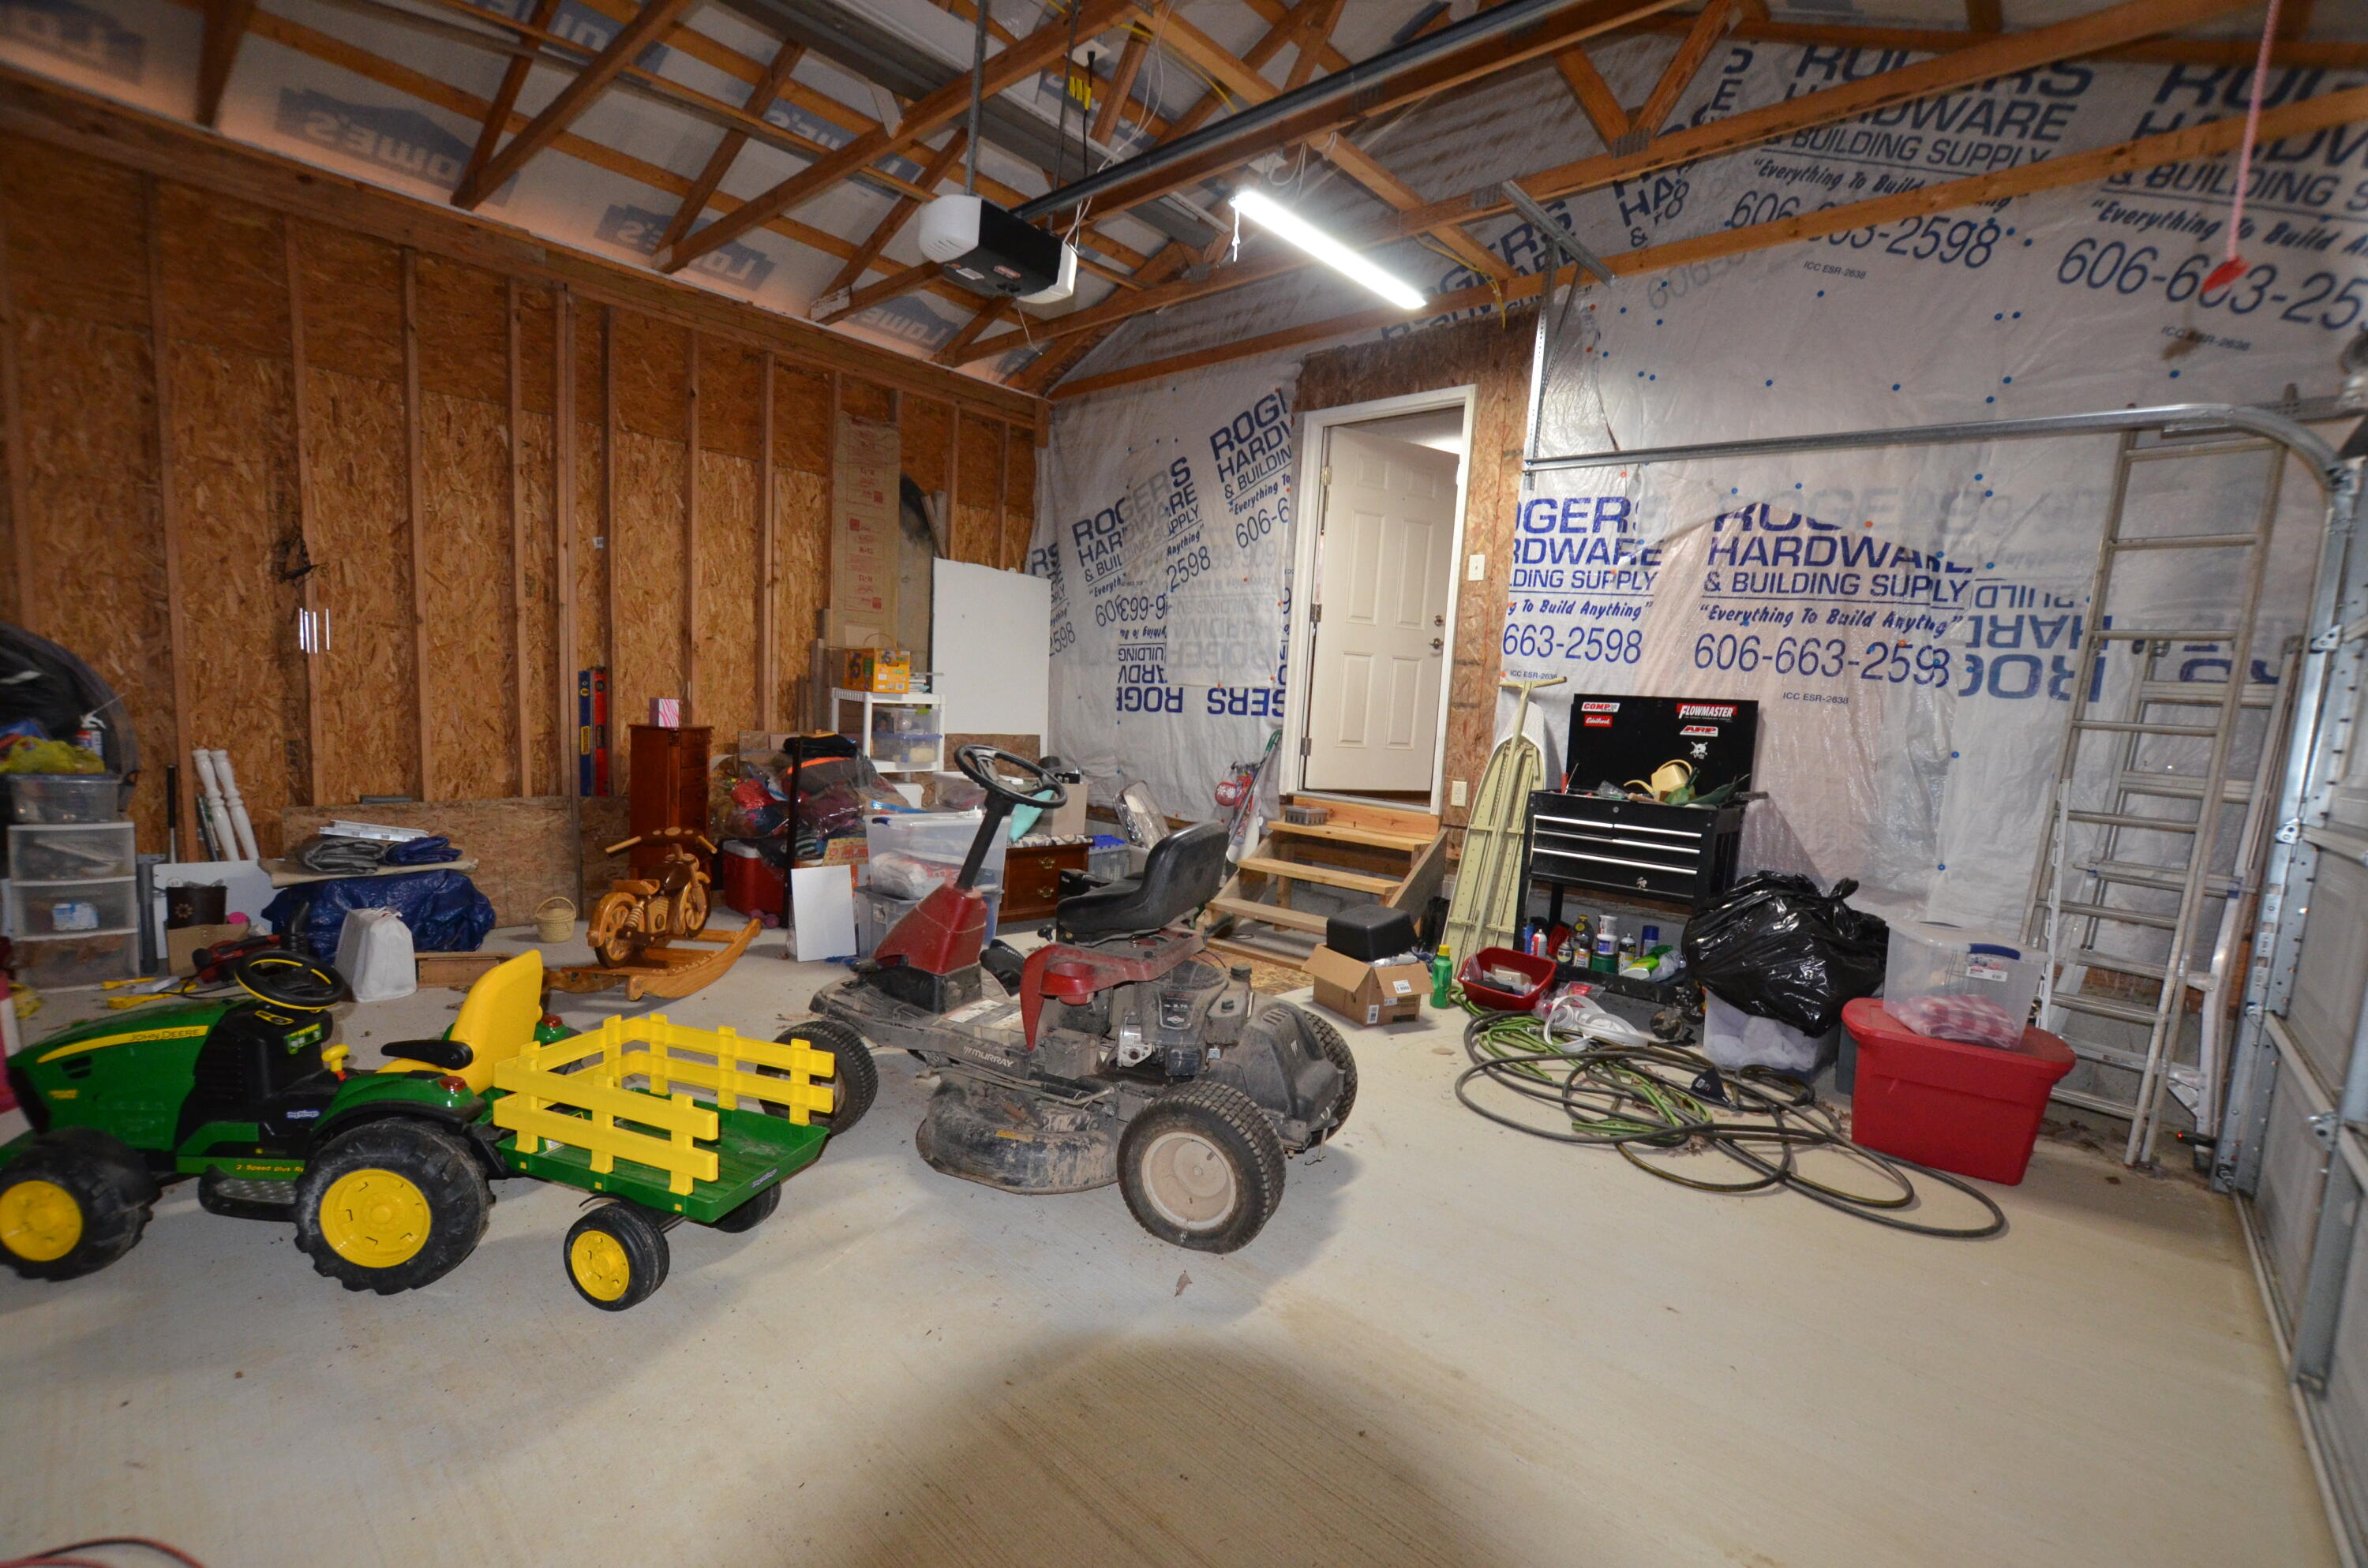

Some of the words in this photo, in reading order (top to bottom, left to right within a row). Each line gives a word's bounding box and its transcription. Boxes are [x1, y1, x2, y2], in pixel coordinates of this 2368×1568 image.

[1785, 83, 2078, 143] DWARE
[1790, 126, 1924, 163] BUILDING
[1848, 170, 1868, 190] To
[2145, 162, 2340, 207] BUILDING
[1729, 189, 2002, 269] 6063-2598
[2262, 221, 2339, 251] Build
[2057, 237, 2368, 331] 606-63-25
[1237, 443, 1293, 492] BUILDIN
[1088, 575, 1122, 598] “Everyth
[1509, 568, 1564, 588] DING
[1571, 569, 1658, 591] SUPPLY
[1703, 571, 1721, 593] &
[1731, 571, 1860, 597] BUILDING
[1870, 574, 1972, 604] SUPLY
[1523, 599, 1534, 612] To
[1539, 600, 1577, 615] Build
[1801, 607, 1818, 624] To
[1826, 608, 1875, 628] Build
[1694, 632, 1950, 688] 606-663-2598
[1583, 702, 1612, 711] COMP
[1782, 691, 1801, 701] ICC
[1803, 693, 1849, 705] ESR-2638
[1679, 704, 1734, 720] FLOWMASTER
[129, 1031, 161, 1043] JOHN
[162, 1027, 200, 1040] DEERE
[971, 1049, 1014, 1068] MURRAY
